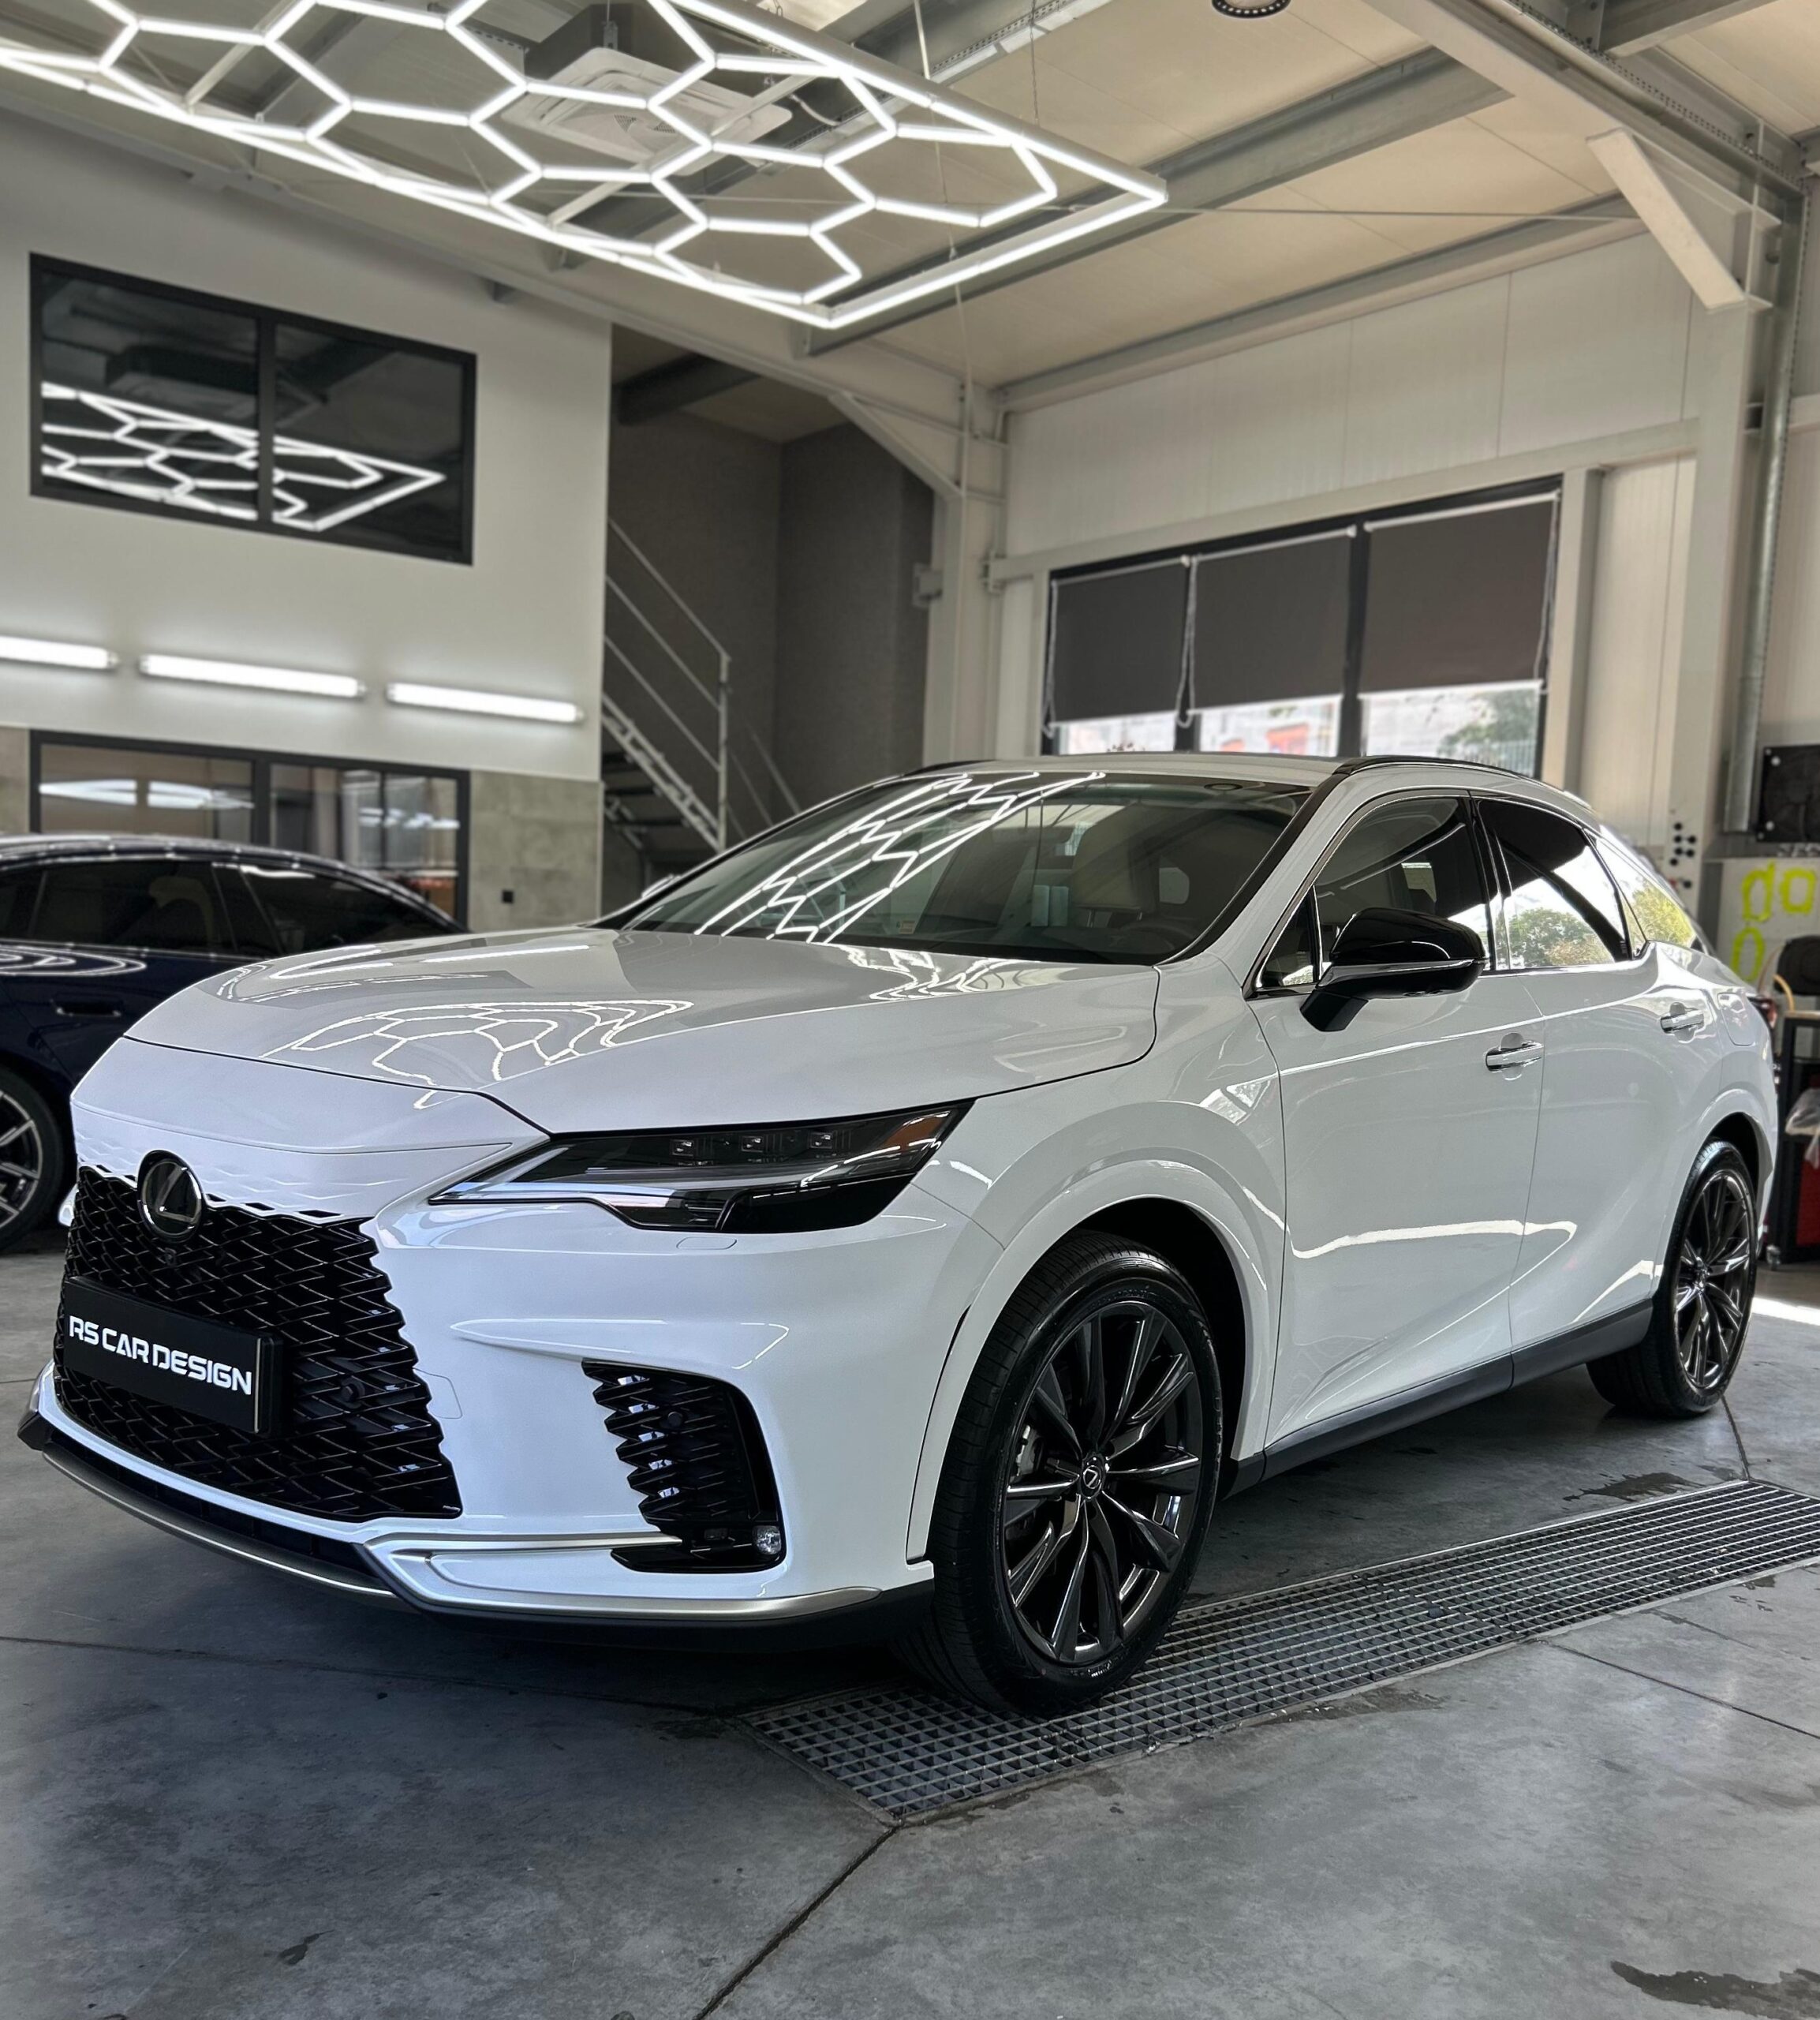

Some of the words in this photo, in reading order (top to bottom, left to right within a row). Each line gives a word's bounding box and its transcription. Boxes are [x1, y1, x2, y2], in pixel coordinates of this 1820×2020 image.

[69, 1315, 99, 1345] RS
[102, 1328, 149, 1364] CAR
[152, 1344, 252, 1395] DESIGN
